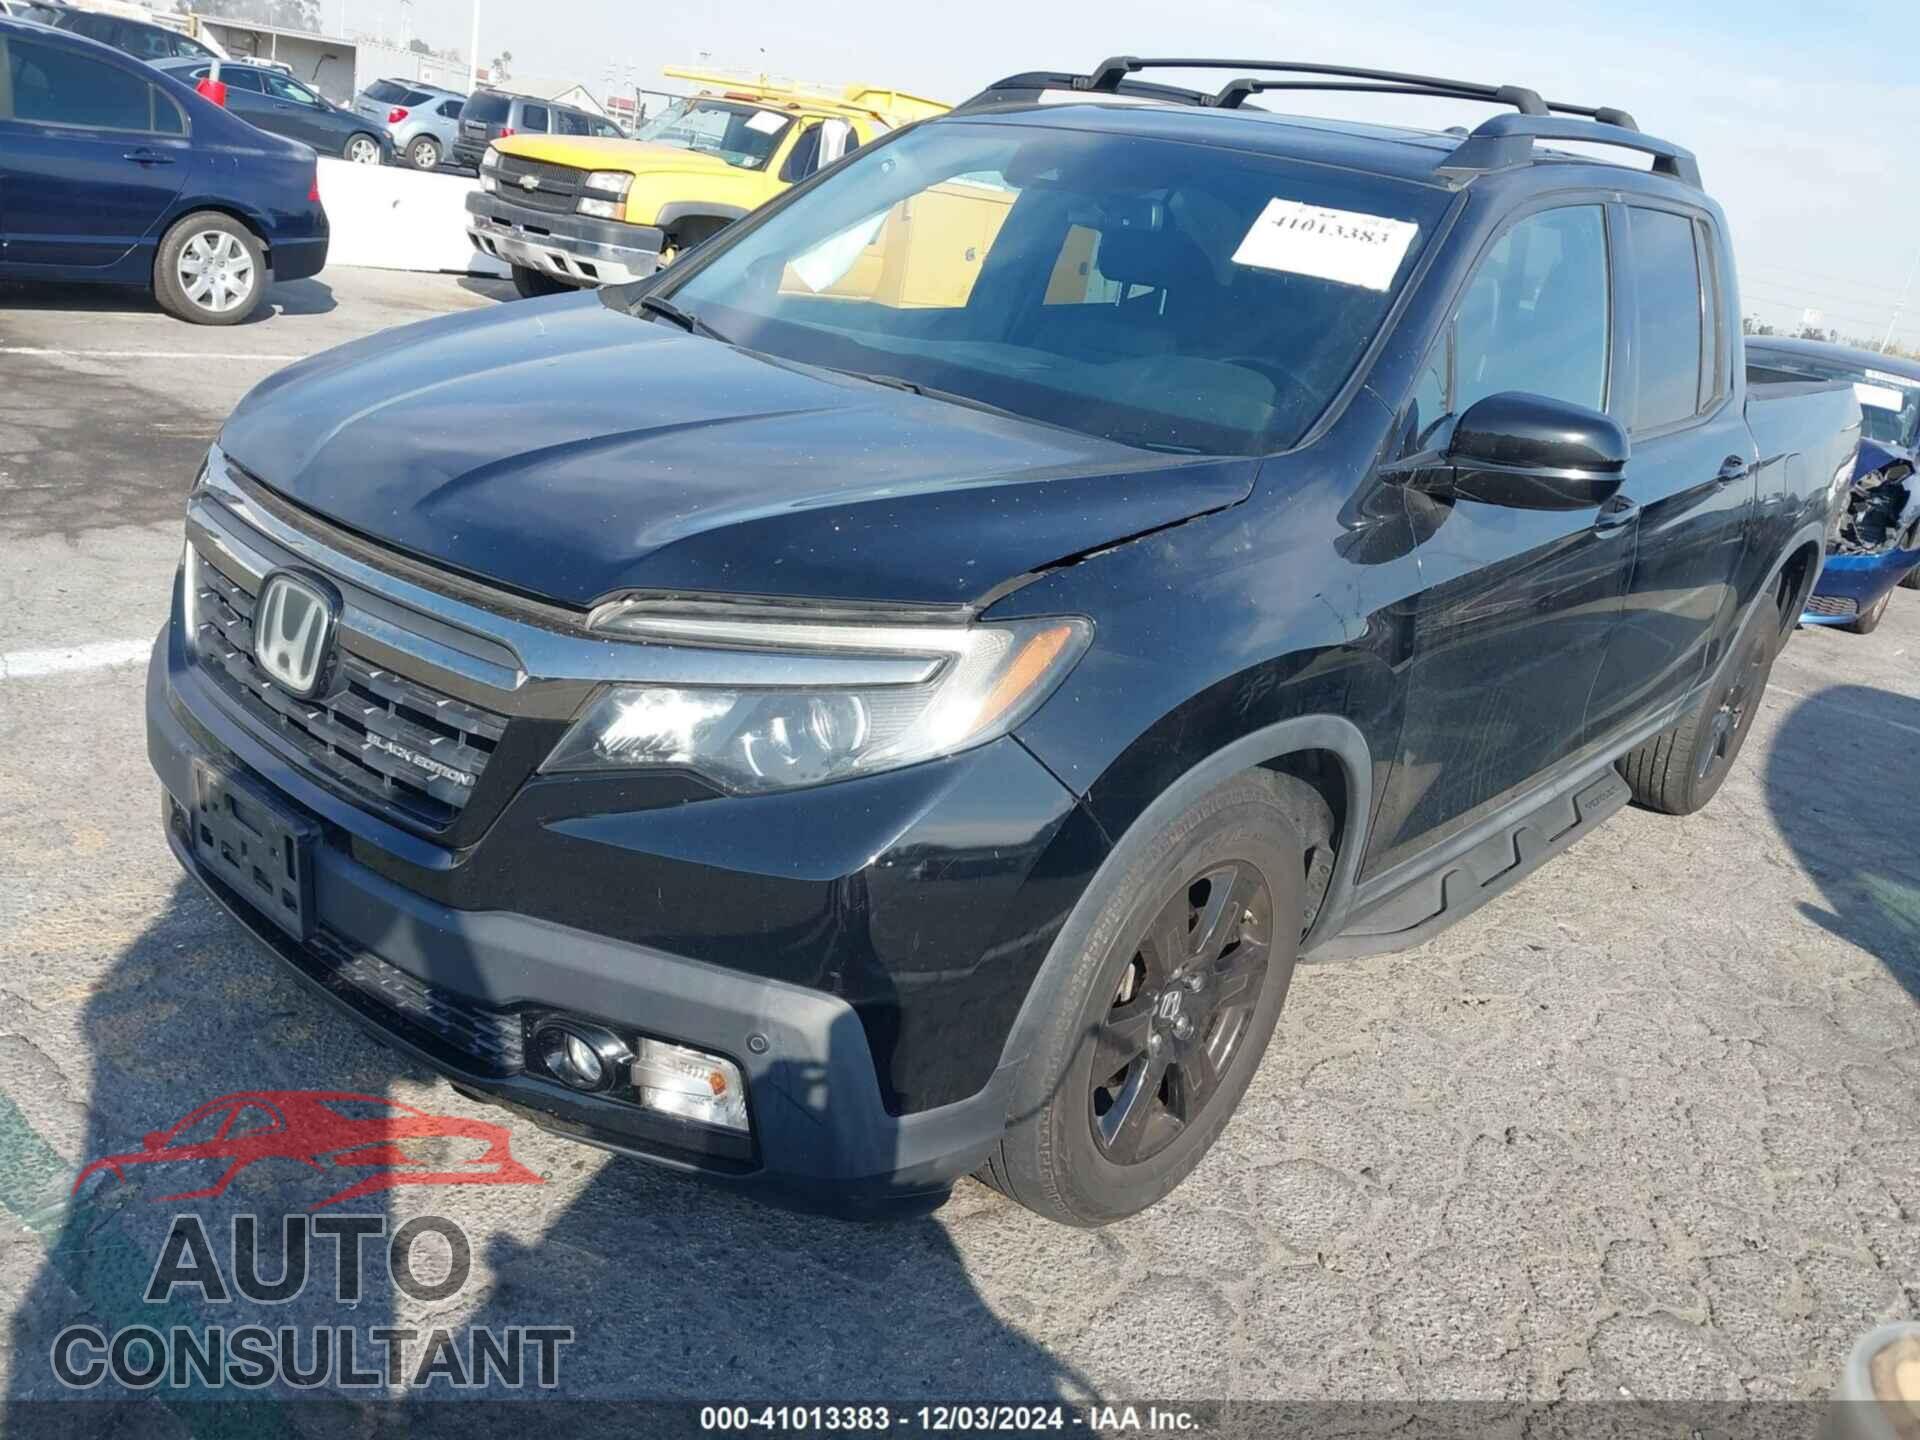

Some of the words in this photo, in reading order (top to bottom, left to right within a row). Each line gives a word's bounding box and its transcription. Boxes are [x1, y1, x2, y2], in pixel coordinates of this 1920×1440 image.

[1271, 216, 1390, 245] 41013383
[366, 731, 416, 762] BLACK
[412, 754, 476, 787] EDITION
